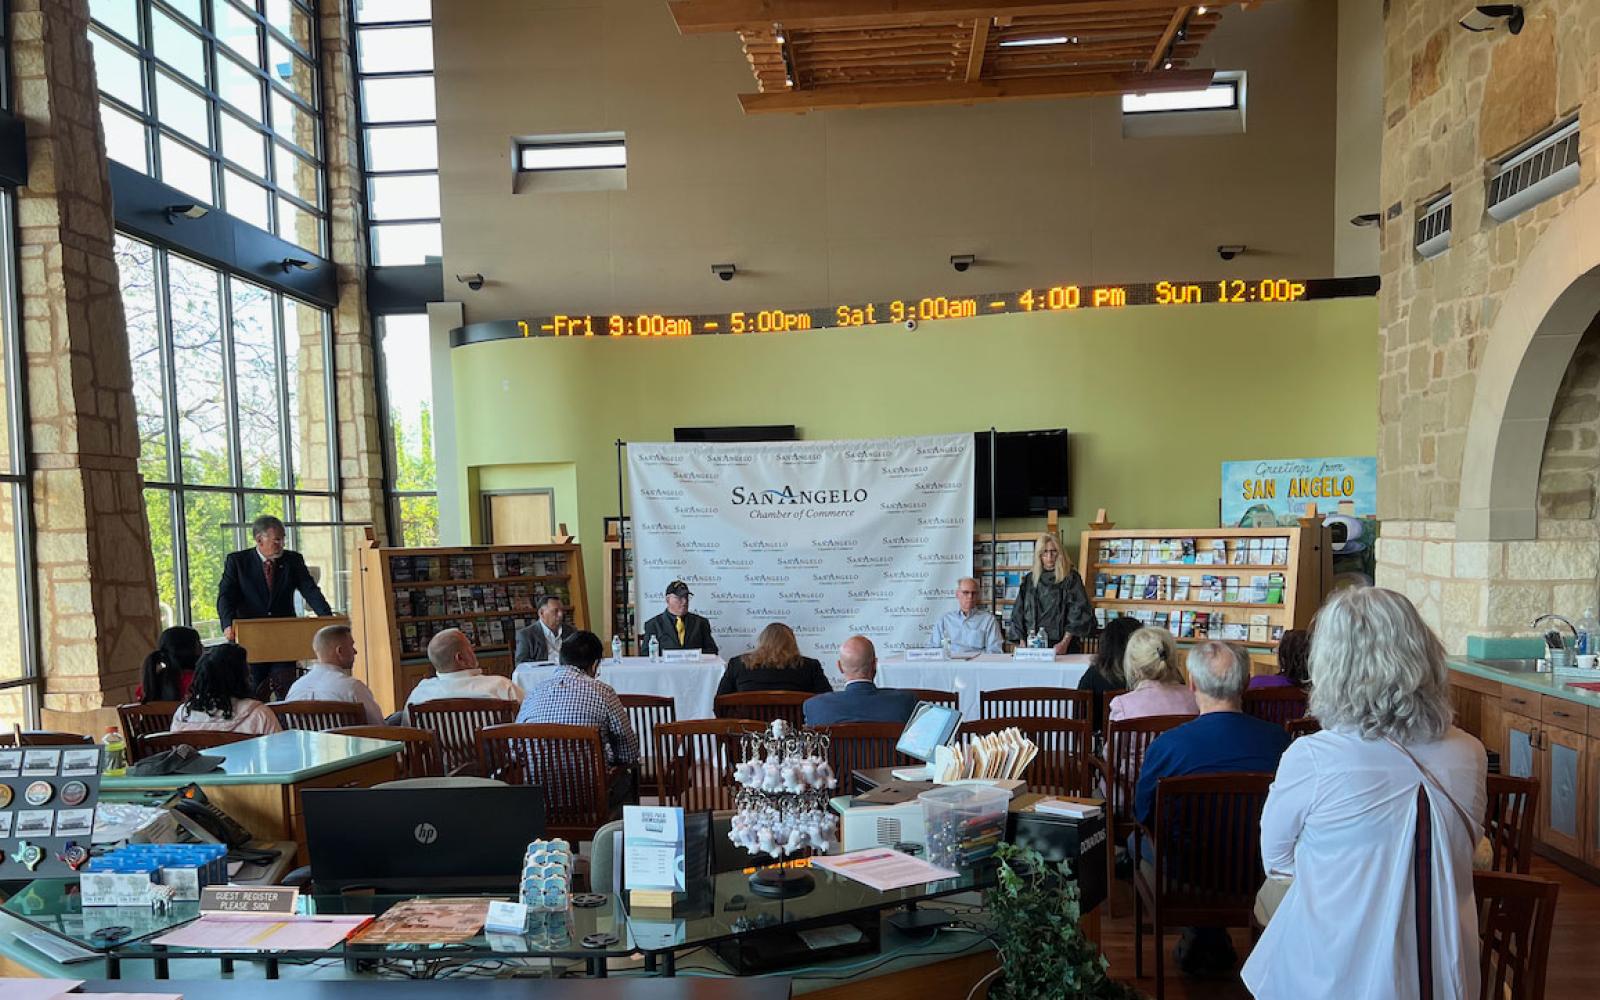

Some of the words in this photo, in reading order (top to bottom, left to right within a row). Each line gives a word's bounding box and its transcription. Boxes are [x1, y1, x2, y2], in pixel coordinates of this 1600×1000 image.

[609, 315, 692, 336] 9:00am
[730, 311, 812, 333] 5:00pm
[836, 303, 877, 325] Sat
[890, 296, 977, 322] 9:00am
[1018, 285, 1081, 311] 4:00
[1156, 281, 1202, 304] Sun
[1217, 279, 1306, 303] 12:00p
[1255, 461, 1313, 477] Greetings
[1319, 461, 1346, 476] from
[731, 486, 774, 505] SAN
[777, 485, 868, 505] ANGELO
[1243, 478, 1276, 500] SAN
[1287, 475, 1355, 498] ANGELO
[750, 508, 791, 519] Chamber
[793, 508, 805, 519] of
[806, 508, 855, 519] Commerce
[416, 822, 437, 844] hp
[215, 891, 239, 901] GUEST
[242, 891, 279, 901] REGISTER
[220, 901, 249, 911] PLEASE
[252, 902, 271, 911] SIGN
